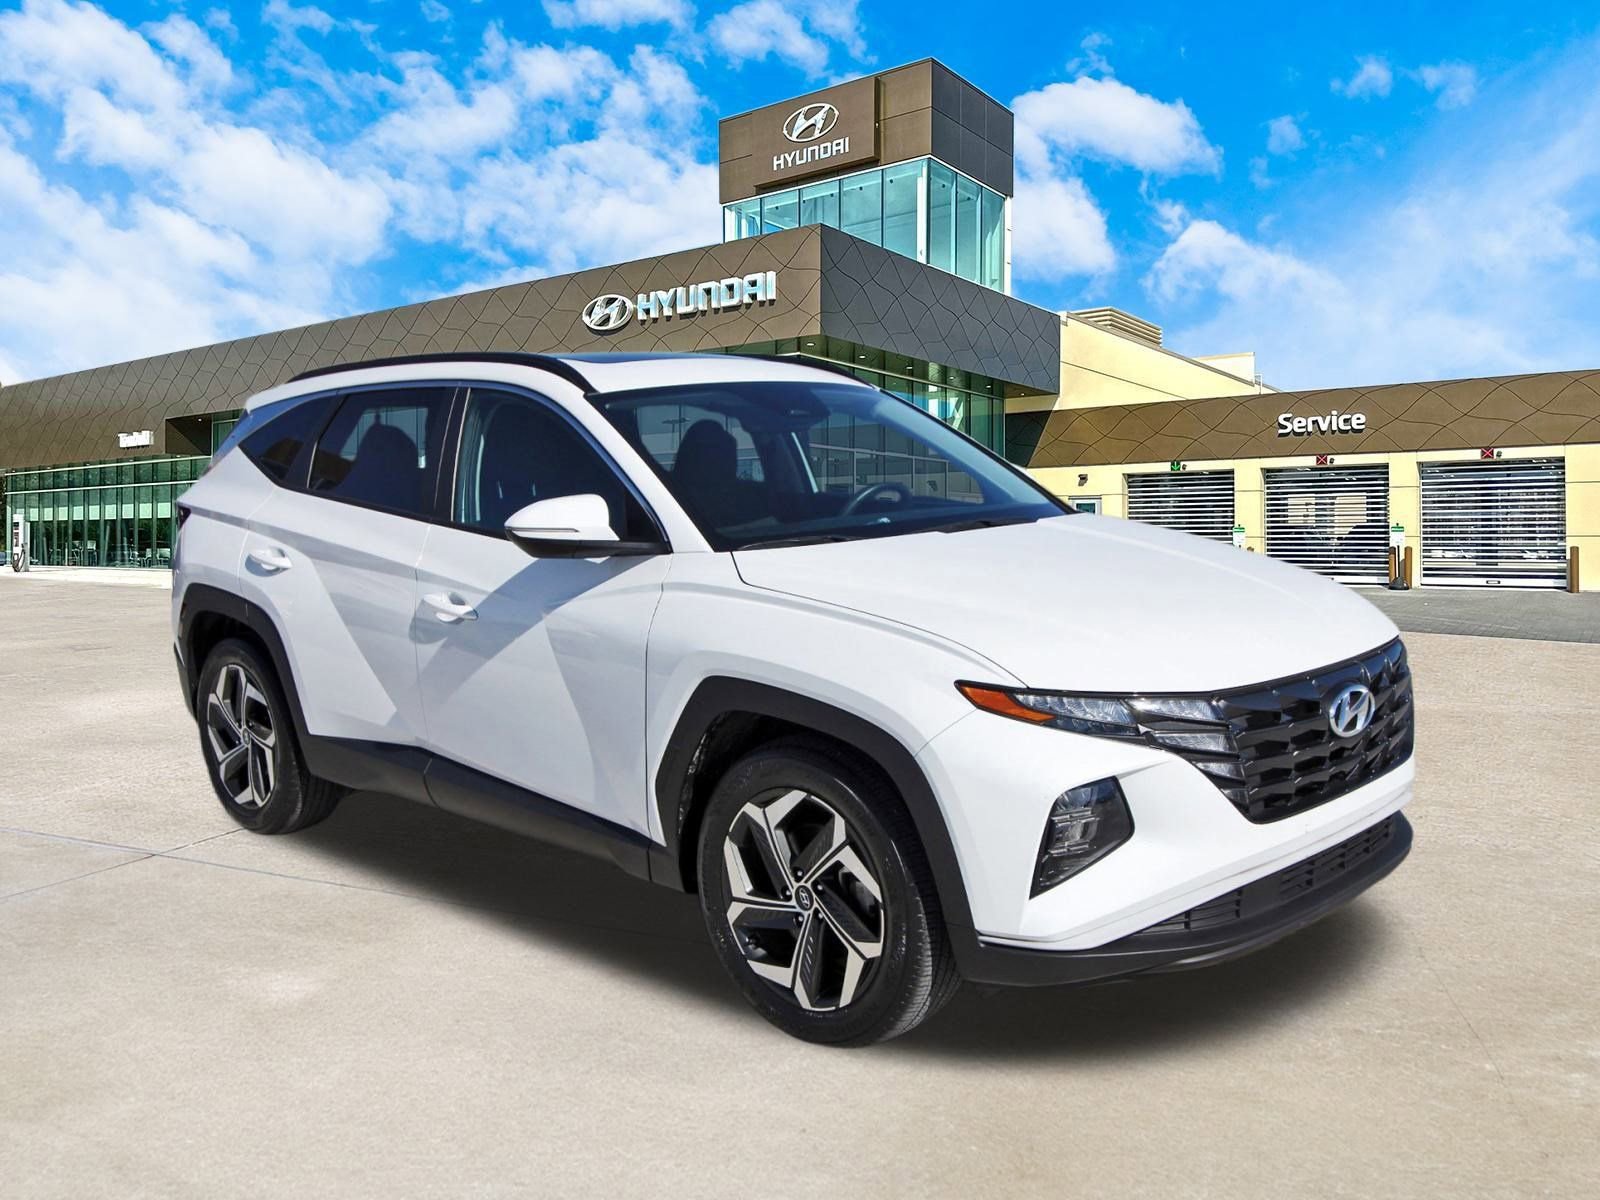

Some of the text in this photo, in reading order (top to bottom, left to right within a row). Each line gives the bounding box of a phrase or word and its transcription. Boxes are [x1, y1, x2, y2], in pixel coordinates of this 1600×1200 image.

[773, 136, 850, 171] HYUNDAI
[636, 271, 777, 321] HYUNDAI
[1278, 410, 1367, 435] Service
